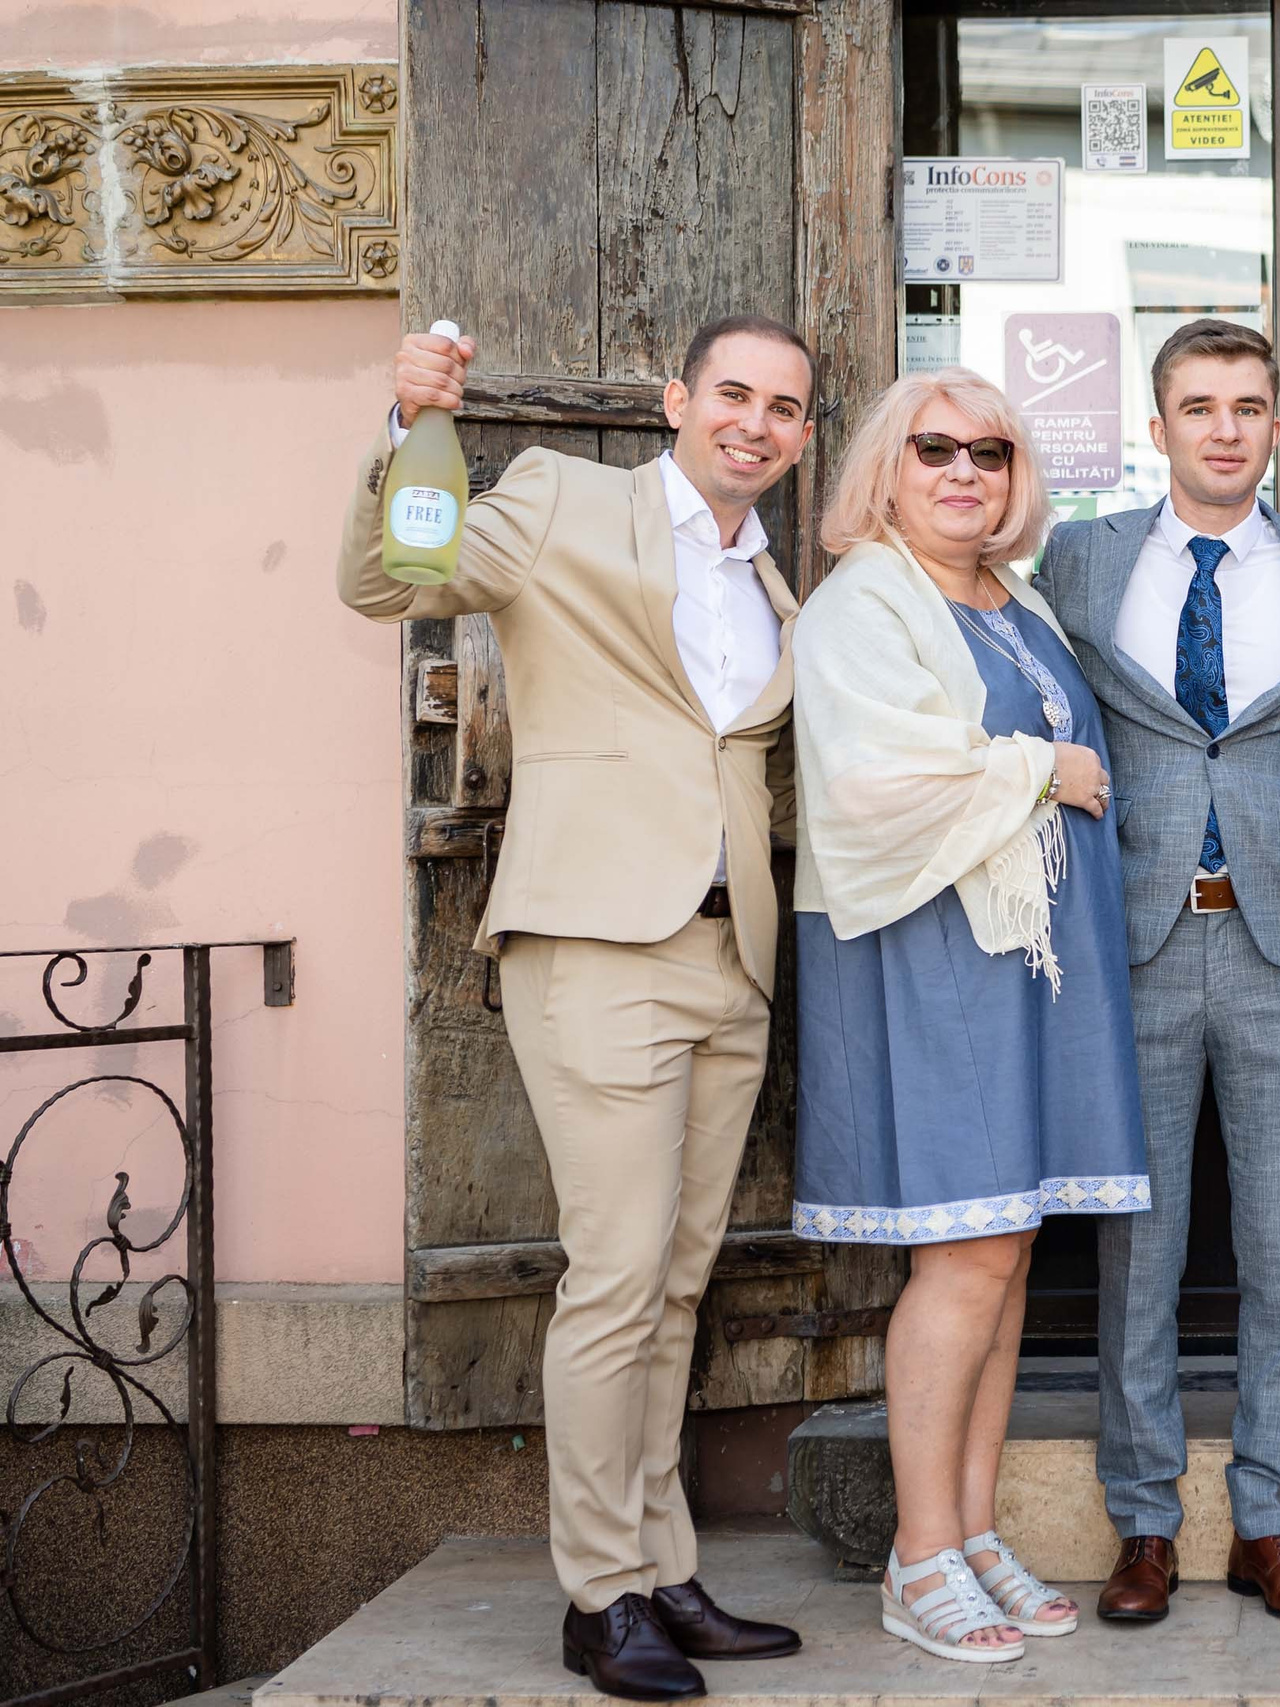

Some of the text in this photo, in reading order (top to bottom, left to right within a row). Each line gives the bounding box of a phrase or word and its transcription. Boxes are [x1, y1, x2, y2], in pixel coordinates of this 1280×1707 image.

[1094, 89, 1134, 97] InfoCons
[1190, 136, 1225, 145] VIDEO
[927, 165, 1027, 187] InfoCons
[1034, 416, 1092, 428] RAMPĂ
[1031, 429, 1096, 440] PENTRU
[1052, 455, 1075, 466] CU
[406, 505, 443, 524] FREE
